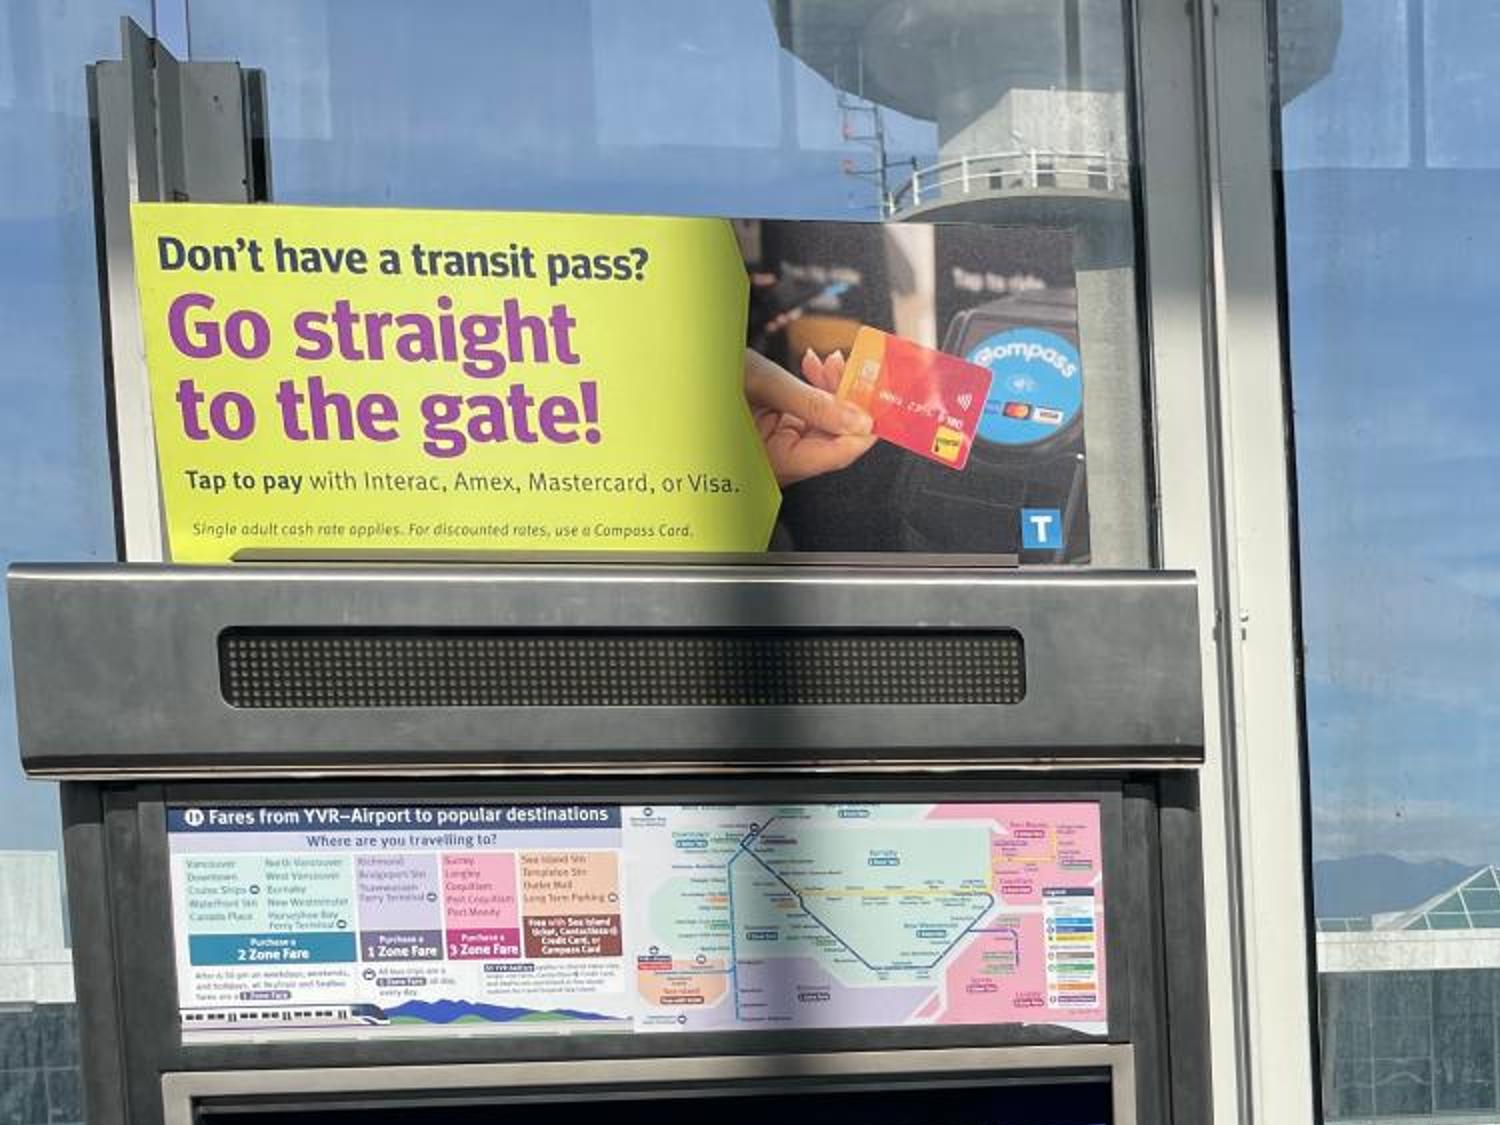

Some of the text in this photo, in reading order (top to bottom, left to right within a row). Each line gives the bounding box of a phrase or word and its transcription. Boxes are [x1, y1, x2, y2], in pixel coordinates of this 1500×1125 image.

[275, 238, 367, 275] have
[379, 248, 401, 276] a
[410, 241, 536, 279] transit
[547, 247, 649, 286] pass?
[168, 294, 580, 378] Go straight
[176, 376, 601, 458] to the gate!
[186, 470, 740, 499] Tap to pay with Interac, Amex, Mastercard, or Visa.
[192, 521, 694, 541] Single adult cash rate applies. For discounted rates, use a Compass Card.
[209, 809, 255, 825] Fares
[259, 808, 299, 824] from
[415, 808, 433, 823] to
[437, 807, 502, 826] popular
[506, 806, 609, 822] destinations
[306, 833, 497, 849] Where are you travelling to?
[238, 948, 310, 961] 2 Zone Fare
[368, 945, 437, 958] 1 Zone Fare
[460, 944, 491, 955] Zone
[493, 944, 519, 955] Fare
